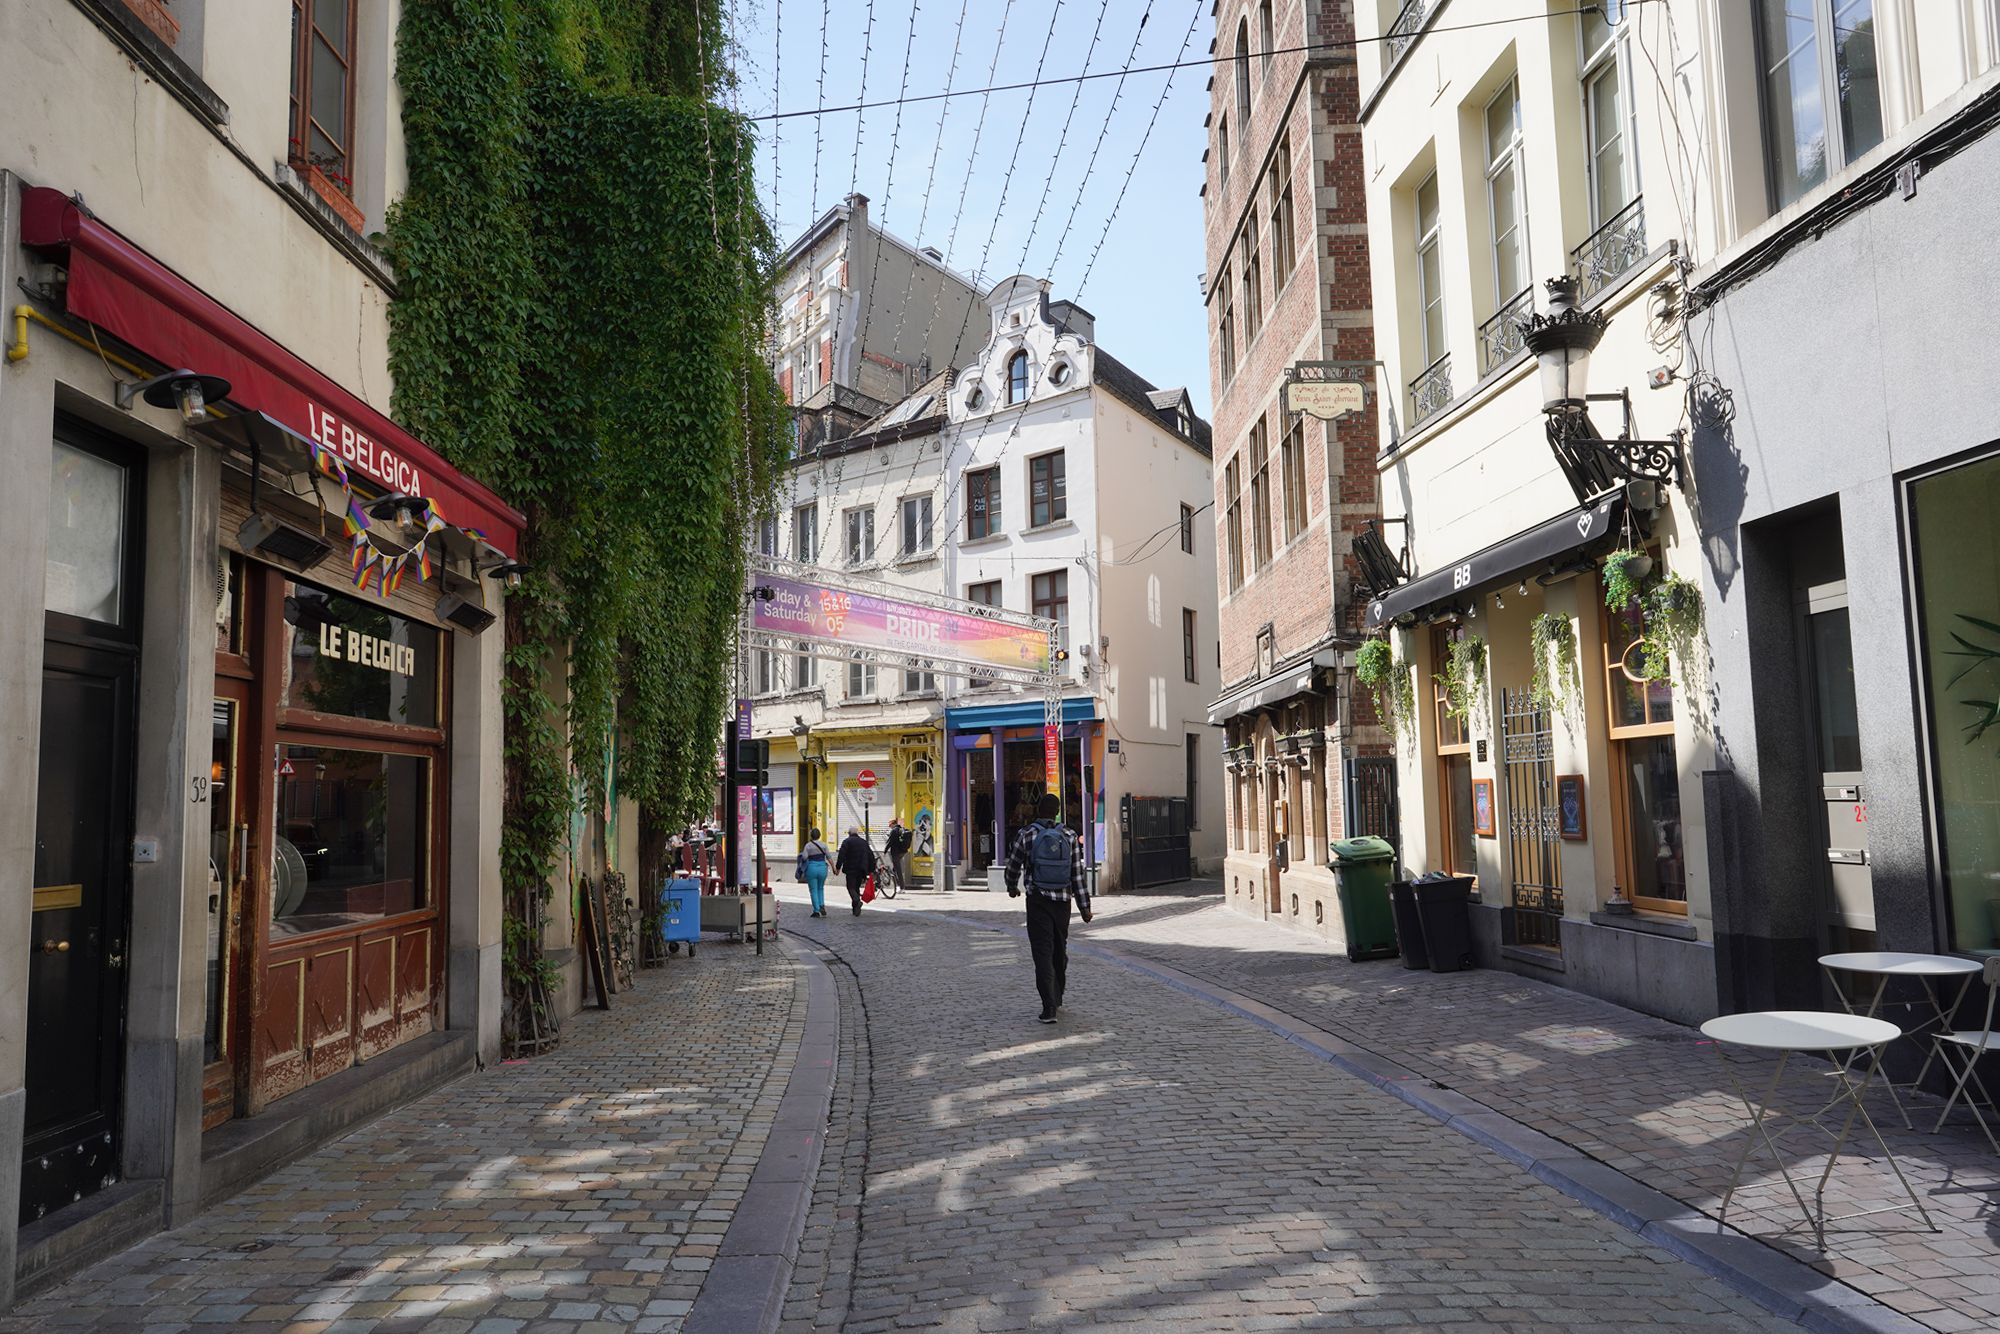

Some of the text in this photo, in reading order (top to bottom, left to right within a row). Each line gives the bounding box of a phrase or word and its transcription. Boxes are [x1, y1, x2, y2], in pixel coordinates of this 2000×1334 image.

[308, 402, 420, 498] LE BELGICA
[1454, 563, 1471, 590] BB
[773, 587, 812, 609] iday &
[819, 596, 852, 612] 15&16
[764, 603, 817, 627] Saturday
[826, 615, 844, 633] 05
[886, 614, 940, 641] PRIDE
[320, 622, 415, 677] LE BELGICA
[191, 776, 207, 803] 32
